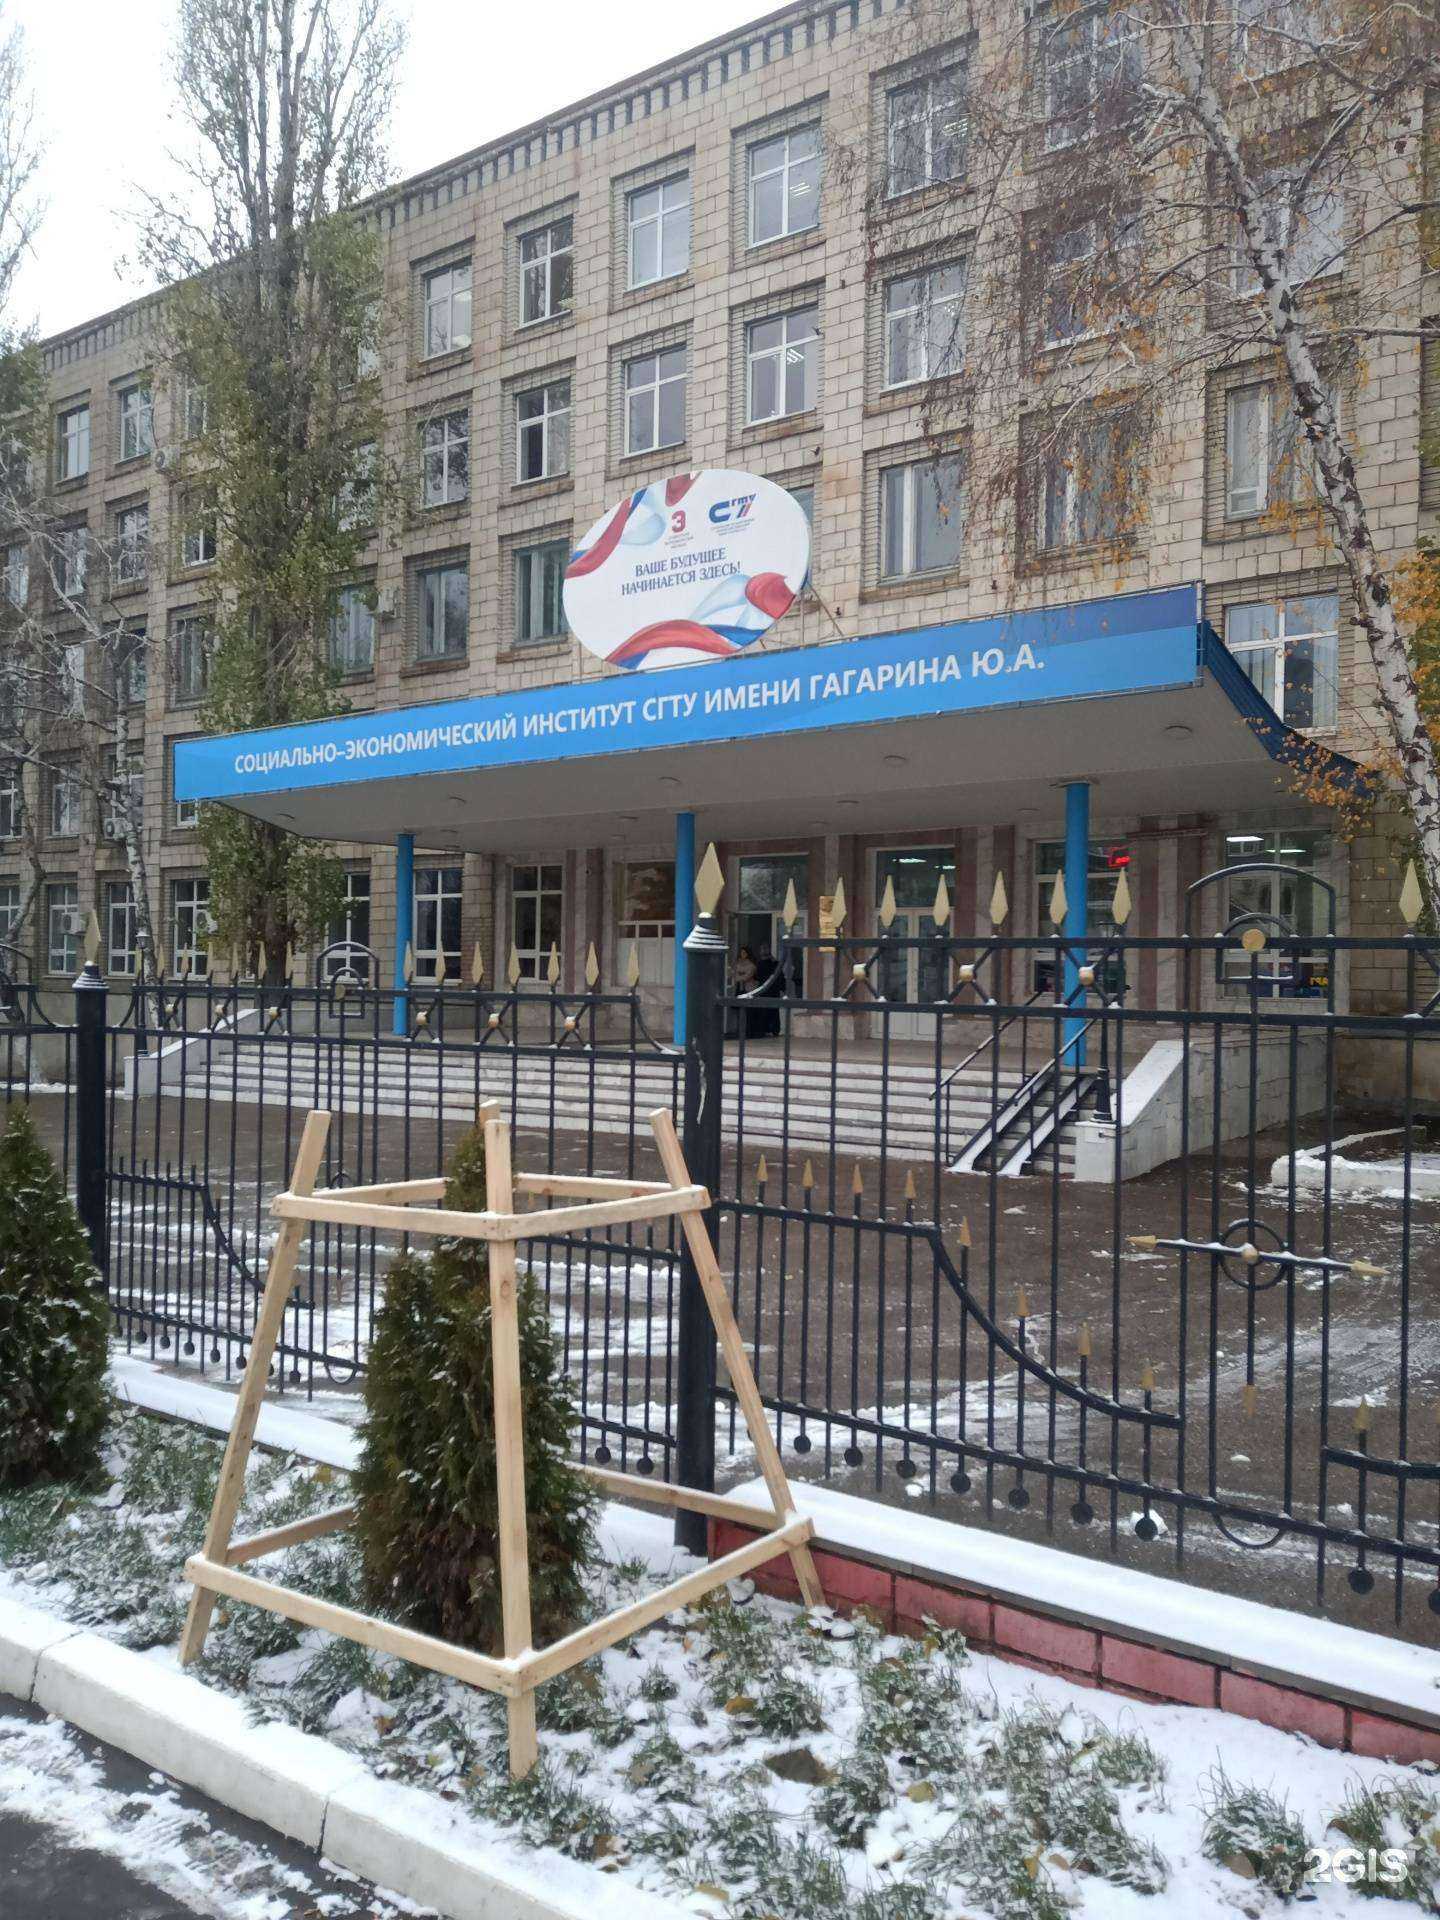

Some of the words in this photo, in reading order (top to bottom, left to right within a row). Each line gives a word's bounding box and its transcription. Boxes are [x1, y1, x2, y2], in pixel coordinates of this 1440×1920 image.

[621, 570, 696, 596] НАЧИНАЕТСЯ
[699, 561, 741, 581] ЗДЕСЬ!
[635, 559, 668, 577] ВАШЕ
[234, 714, 517, 774] СОЦИАЛЬНО-ЭКОНОМИЧЕСКИЙ
[523, 700, 637, 737] ИНСТИТУТ
[642, 692, 698, 722] СГТУ
[704, 677, 801, 714] ИМЕНИ
[809, 655, 960, 700] ГАГАРИНА
[971, 643, 1045, 675] Ю.А.
